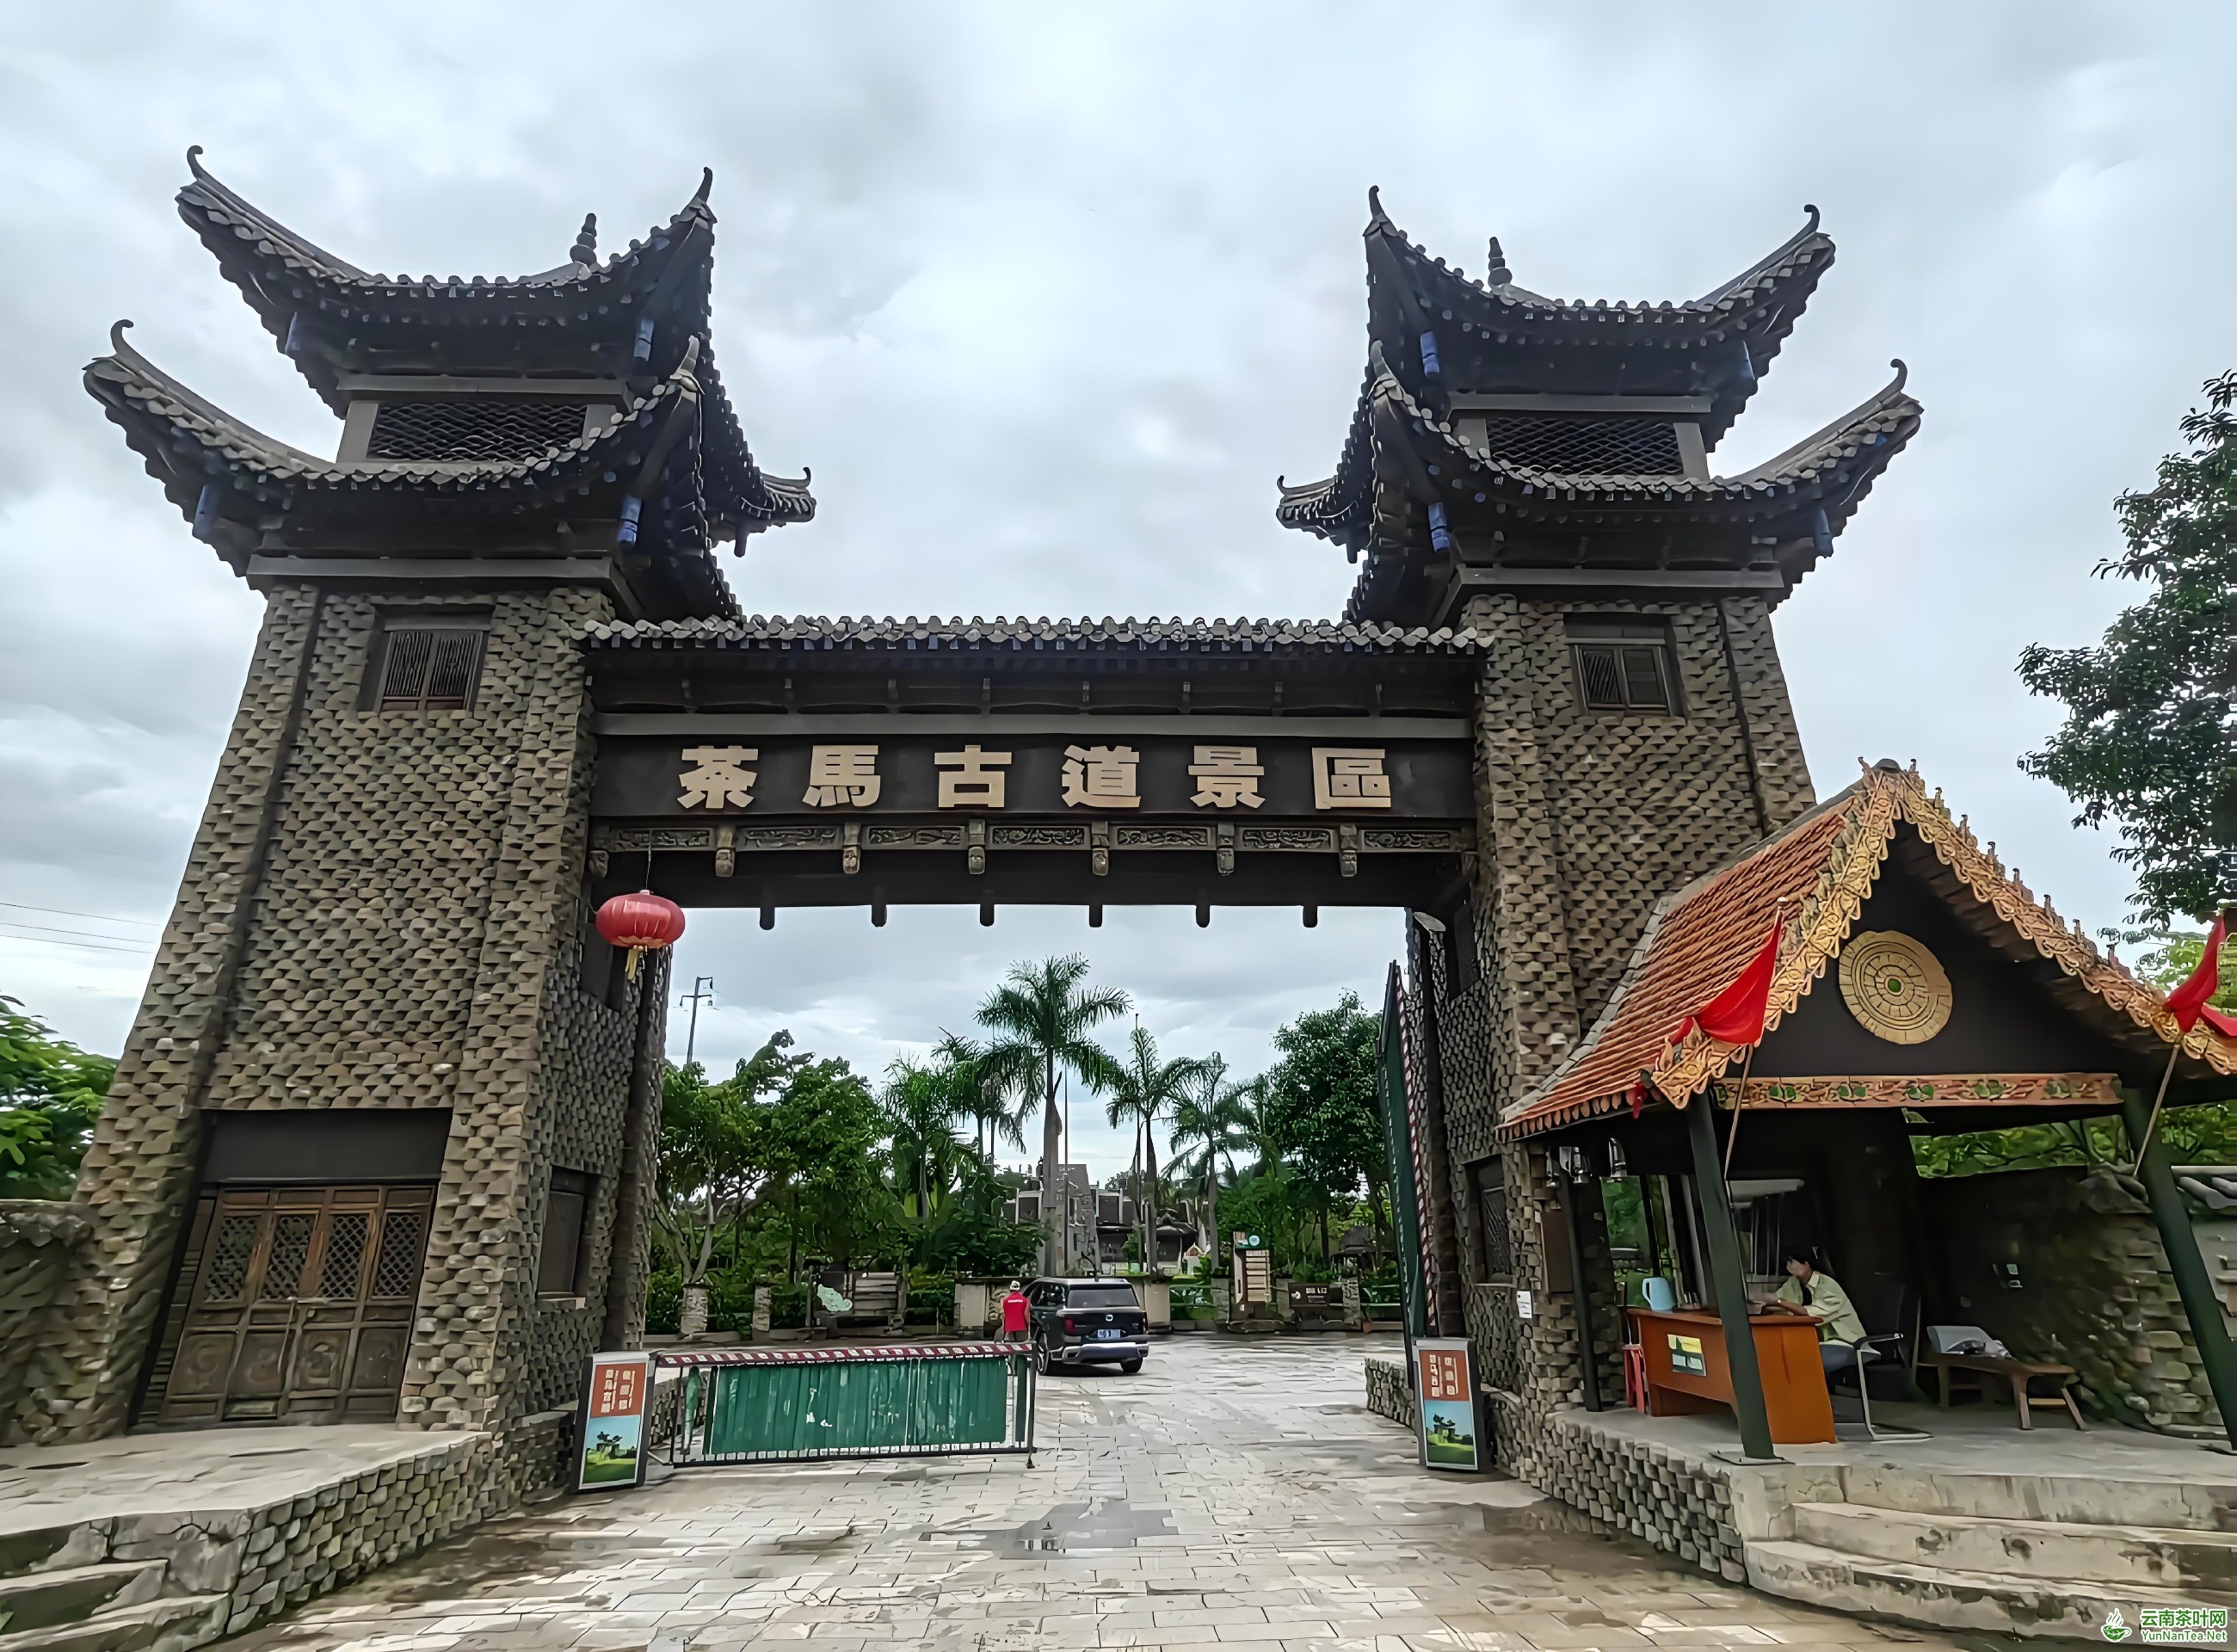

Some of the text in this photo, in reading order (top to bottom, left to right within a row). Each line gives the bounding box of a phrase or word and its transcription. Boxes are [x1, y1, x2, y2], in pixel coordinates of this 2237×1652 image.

[677, 745, 1391, 809] 茶馬古道景區
